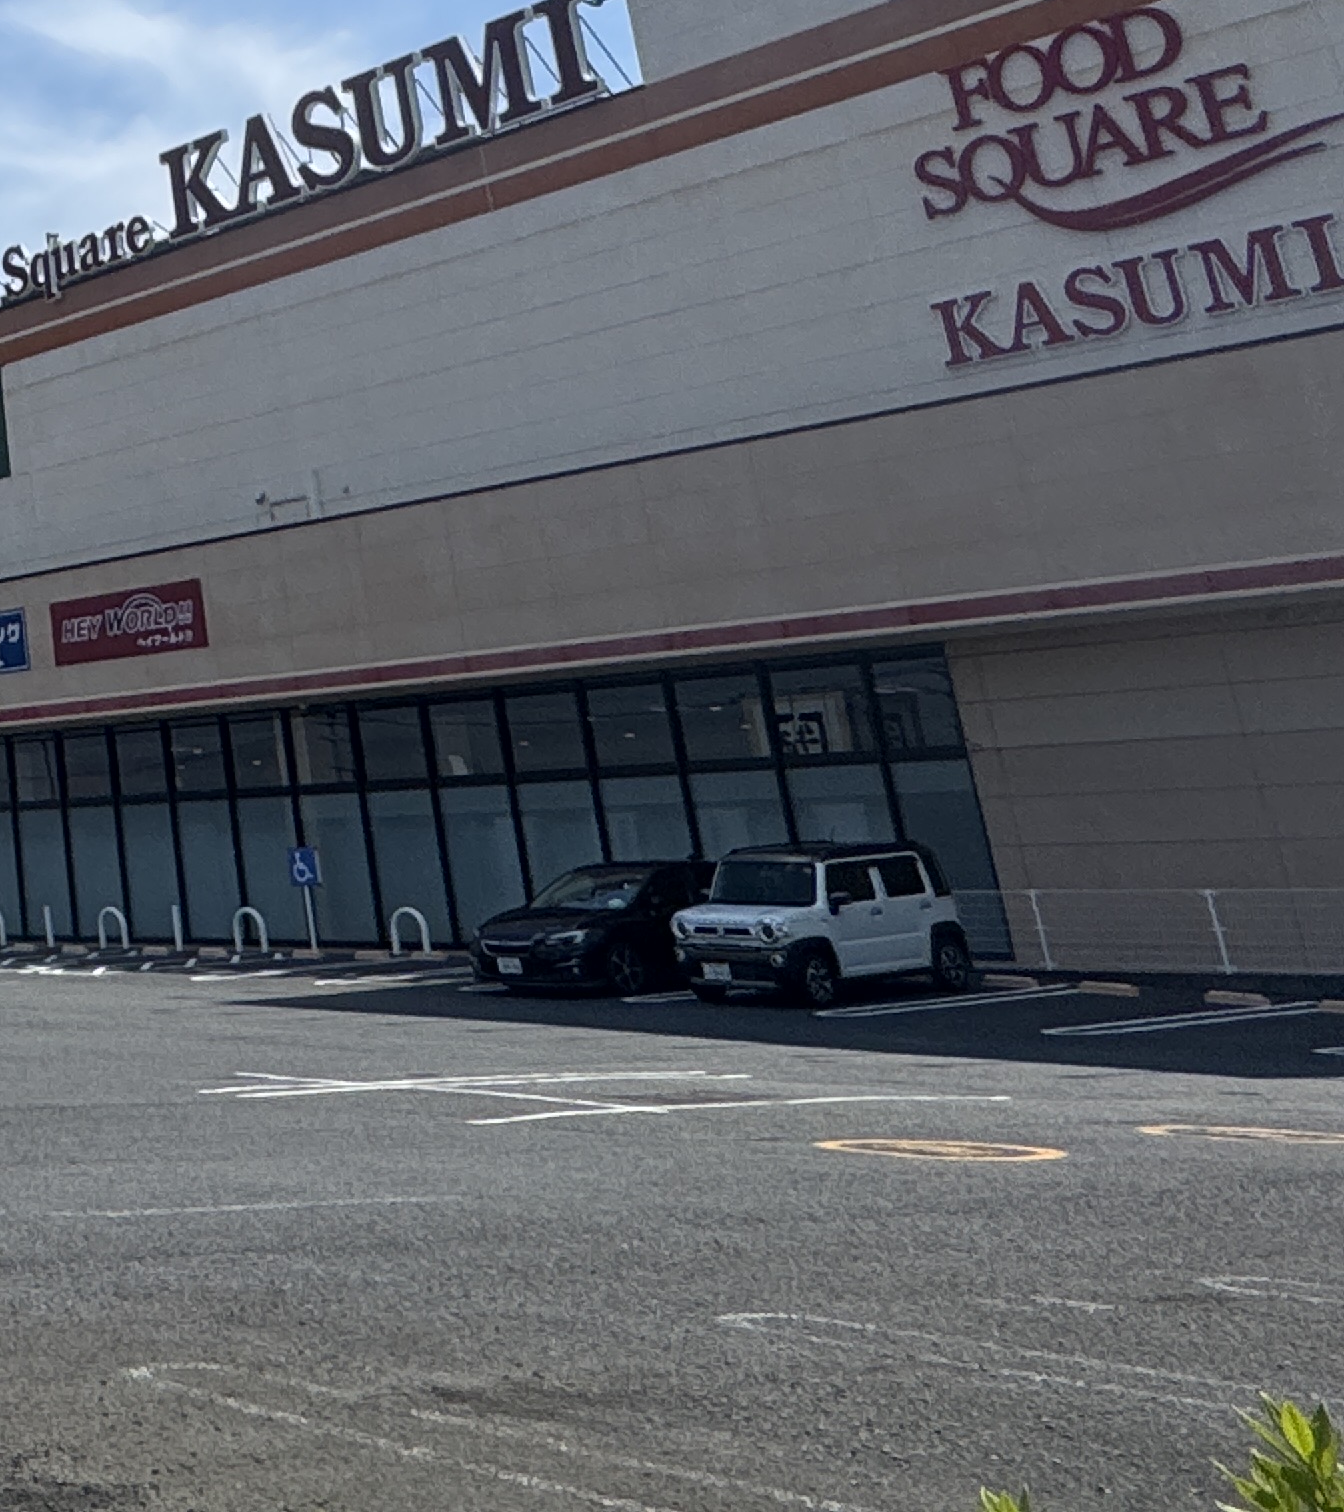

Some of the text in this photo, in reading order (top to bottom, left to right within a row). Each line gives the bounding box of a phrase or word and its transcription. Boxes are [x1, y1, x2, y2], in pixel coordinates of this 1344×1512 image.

[940, 7, 1183, 131] FOOD
[915, 63, 1282, 225] SQUARE
[2, 214, 154, 299] Square
[930, 213, 1344, 368] KASUMI
[62, 615, 103, 643] HEY
